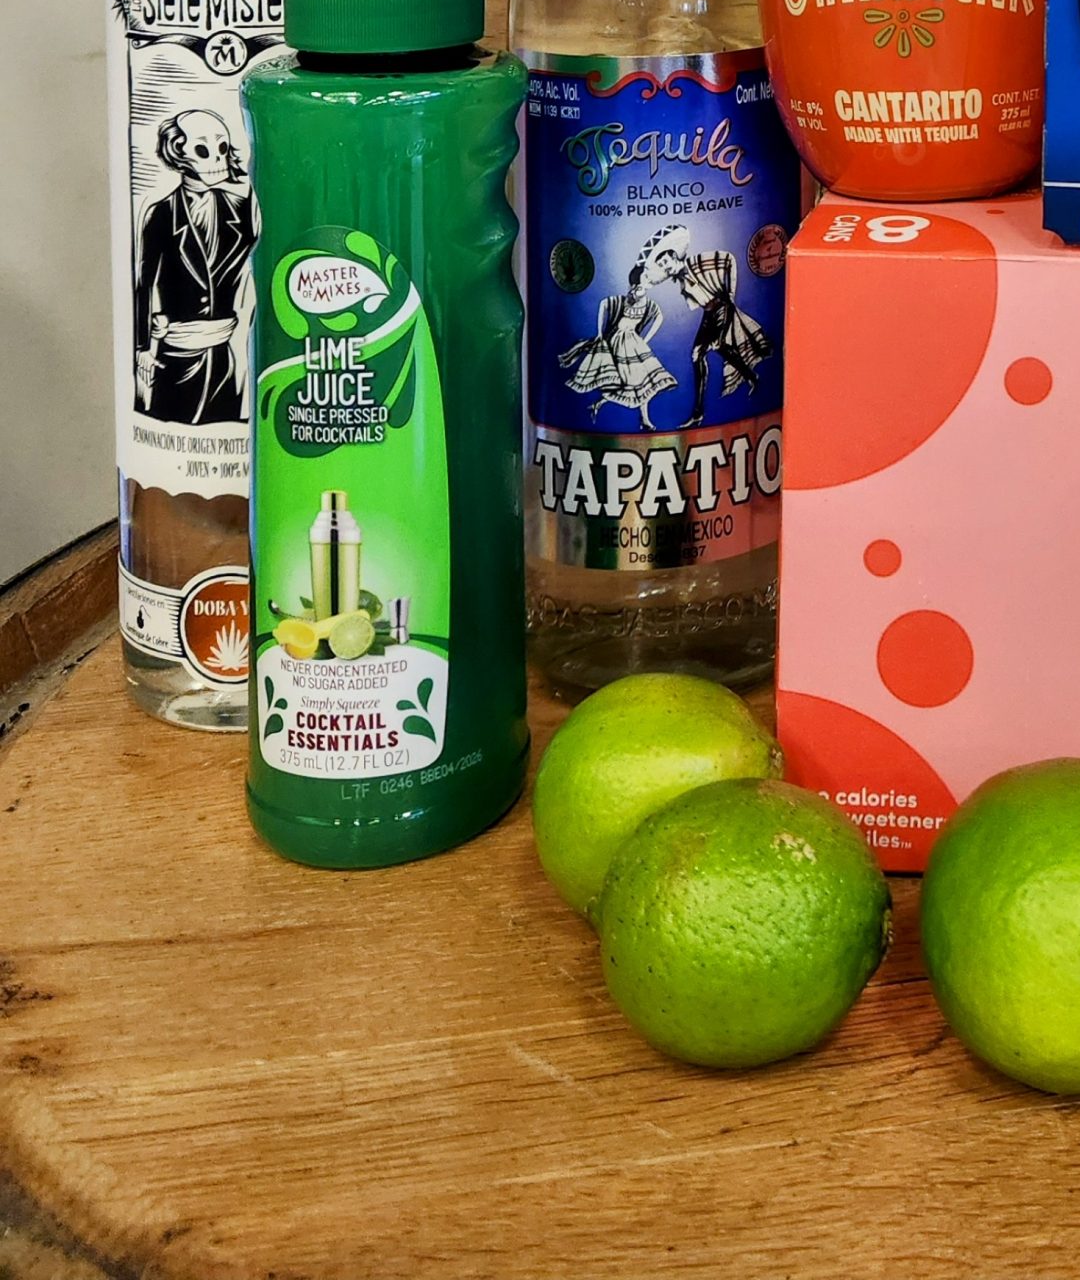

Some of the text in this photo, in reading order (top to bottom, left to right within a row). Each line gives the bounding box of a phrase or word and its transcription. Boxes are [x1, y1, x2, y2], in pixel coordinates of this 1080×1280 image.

[736, 85, 759, 105] Cont.
[834, 88, 983, 122] CANTARITO
[991, 90, 1021, 106] CONT.
[807, 102, 824, 116] 8%
[1001, 107, 1019, 120] 375
[844, 126, 883, 143] MADE
[886, 127, 922, 144] WITH
[924, 123, 978, 143] TEQUILA
[560, 118, 753, 196] Tequila
[627, 182, 705, 200] BLANCO
[588, 195, 744, 217] 100% PURO DE AGAVE
[823, 214, 862, 243] CANS
[298, 266, 358, 291] MASTER
[313, 281, 361, 302] MIXES
[305, 336, 365, 371] LIME
[297, 372, 374, 406] JUICE
[288, 405, 388, 425] SINGLE PRESSED
[292, 425, 384, 443] FOR COCKTAILS
[176, 435, 216, 455] DE ORIGEN
[185, 461, 210, 477] JOVEN
[533, 424, 781, 518] TAPATIO
[600, 525, 651, 549] HECHO
[281, 659, 408, 677] NEVER CONCENTRATED
[293, 676, 388, 691] NO SUGAR ADDED
[301, 695, 380, 712] Simply Squeeze
[296, 712, 387, 731] COCKTAIL
[288, 729, 398, 752] ESSENTIALS
[280, 748, 410, 773] 375 mL (12.7 FL OZ)
[380, 776, 414, 795] 0246
[836, 787, 917, 808] calories
